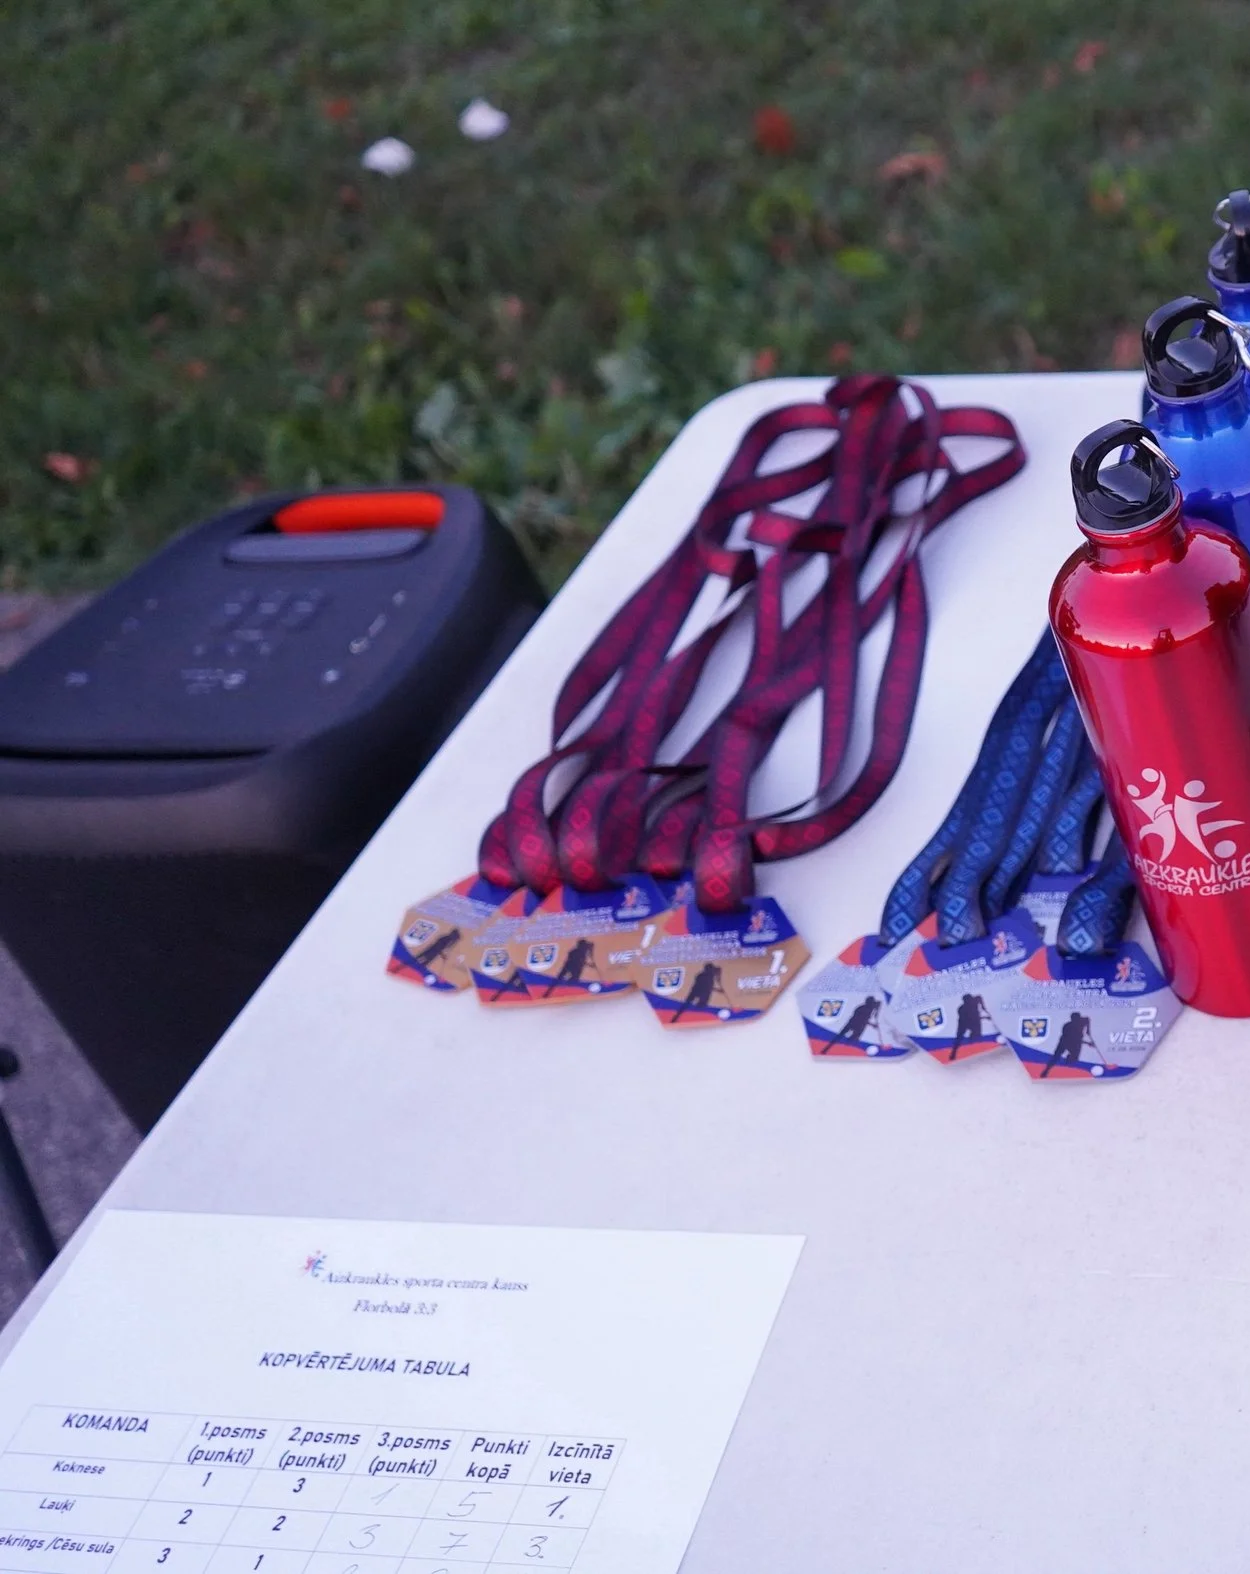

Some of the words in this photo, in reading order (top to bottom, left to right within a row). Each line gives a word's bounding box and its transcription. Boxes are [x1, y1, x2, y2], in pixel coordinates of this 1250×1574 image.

[1143, 874, 1194, 896] SPORTA
[769, 950, 789, 975] 1.
[736, 975, 781, 991] VIETA
[1133, 1006, 1162, 1029] 2.
[1109, 1030, 1155, 1044] VIETA
[402, 1277, 444, 1291] sporta
[447, 1278, 488, 1291] centra
[491, 1277, 529, 1292] kauss
[258, 1350, 397, 1373] KOPVĒRTĒJUMA
[402, 1359, 472, 1377] TABULA
[61, 1413, 150, 1433] KOMANDA
[200, 1421, 268, 1441] 1.posms
[288, 1426, 361, 1446] 2.posms
[377, 1431, 452, 1452] 3.posms
[471, 1436, 531, 1456] Punkti
[187, 1444, 255, 1466] (punkti)
[548, 1440, 615, 1461] Izcīnītā
[52, 1460, 106, 1475] Koknese
[278, 1450, 347, 1472] (punkti)
[368, 1455, 438, 1477] (punkti)
[202, 1472, 212, 1487] 1
[465, 1462, 512, 1483] kopā
[549, 1468, 593, 1485] vieta
[292, 1477, 306, 1493] 3
[370, 1483, 400, 1506] 1
[39, 1497, 77, 1514] Lauķi
[446, 1491, 492, 1518] 5
[545, 1495, 571, 1520] 1.
[178, 1509, 193, 1525] 2
[272, 1515, 287, 1531] 2
[0, 1534, 45, 1551] ekrings
[86, 1541, 116, 1554] sula
[349, 1523, 381, 1550] 3
[439, 1532, 469, 1555] 7
[156, 1547, 171, 1563] 3
[524, 1535, 549, 1559] 3.
[254, 1554, 264, 1570] 1
